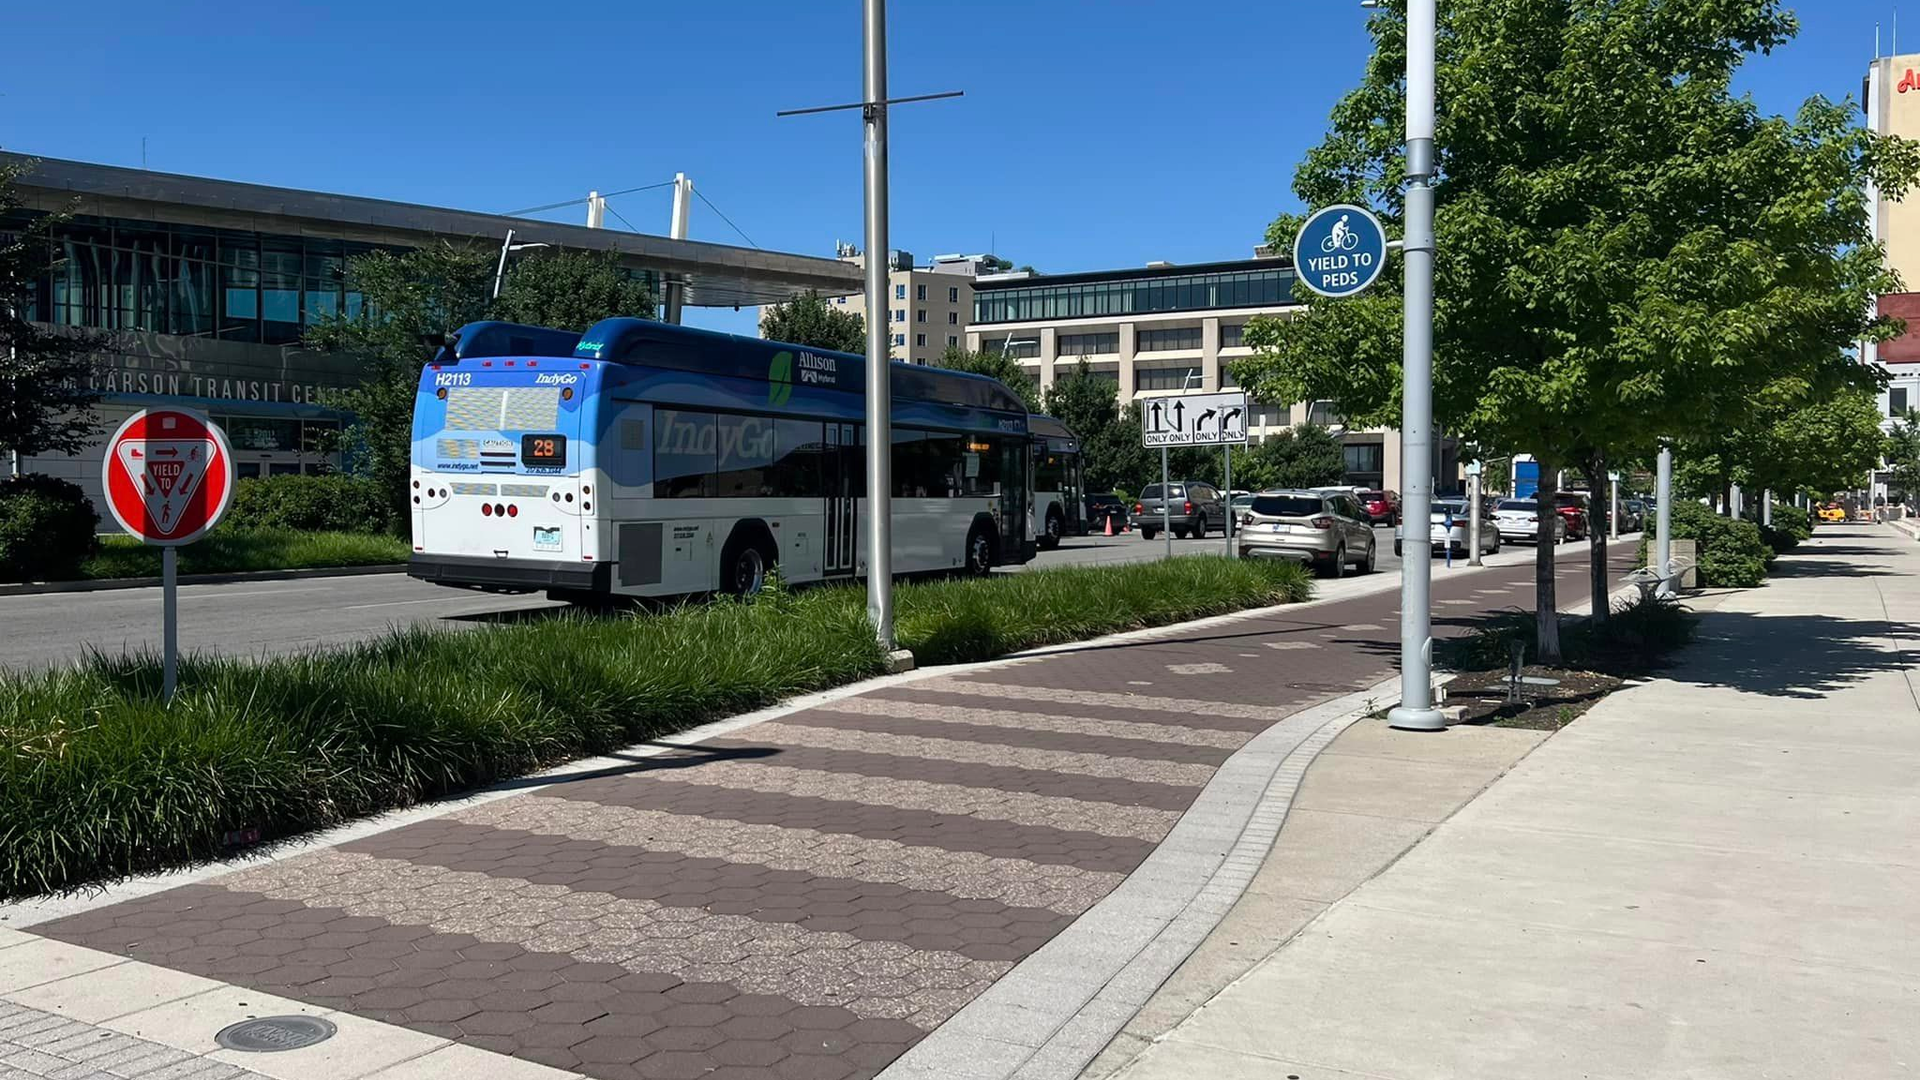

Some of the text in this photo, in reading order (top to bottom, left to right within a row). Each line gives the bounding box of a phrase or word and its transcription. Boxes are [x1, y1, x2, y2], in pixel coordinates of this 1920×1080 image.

[1897, 68, 1920, 94] A
[1308, 252, 1372, 271] YIELD TO
[1323, 271, 1359, 287] PEDS
[798, 351, 836, 372] Allison
[435, 373, 471, 386] H2113
[535, 373, 578, 385] IndyGo
[90, 372, 179, 396] CARSON
[193, 377, 281, 402] TRANSIT
[292, 384, 361, 406] CENT
[655, 409, 778, 466] IndyGo
[1146, 430, 1245, 443] ONLY ONLY ONLY ONLY
[533, 439, 554, 456] 28
[153, 464, 180, 476] YIELD
[161, 477, 171, 490] TO
